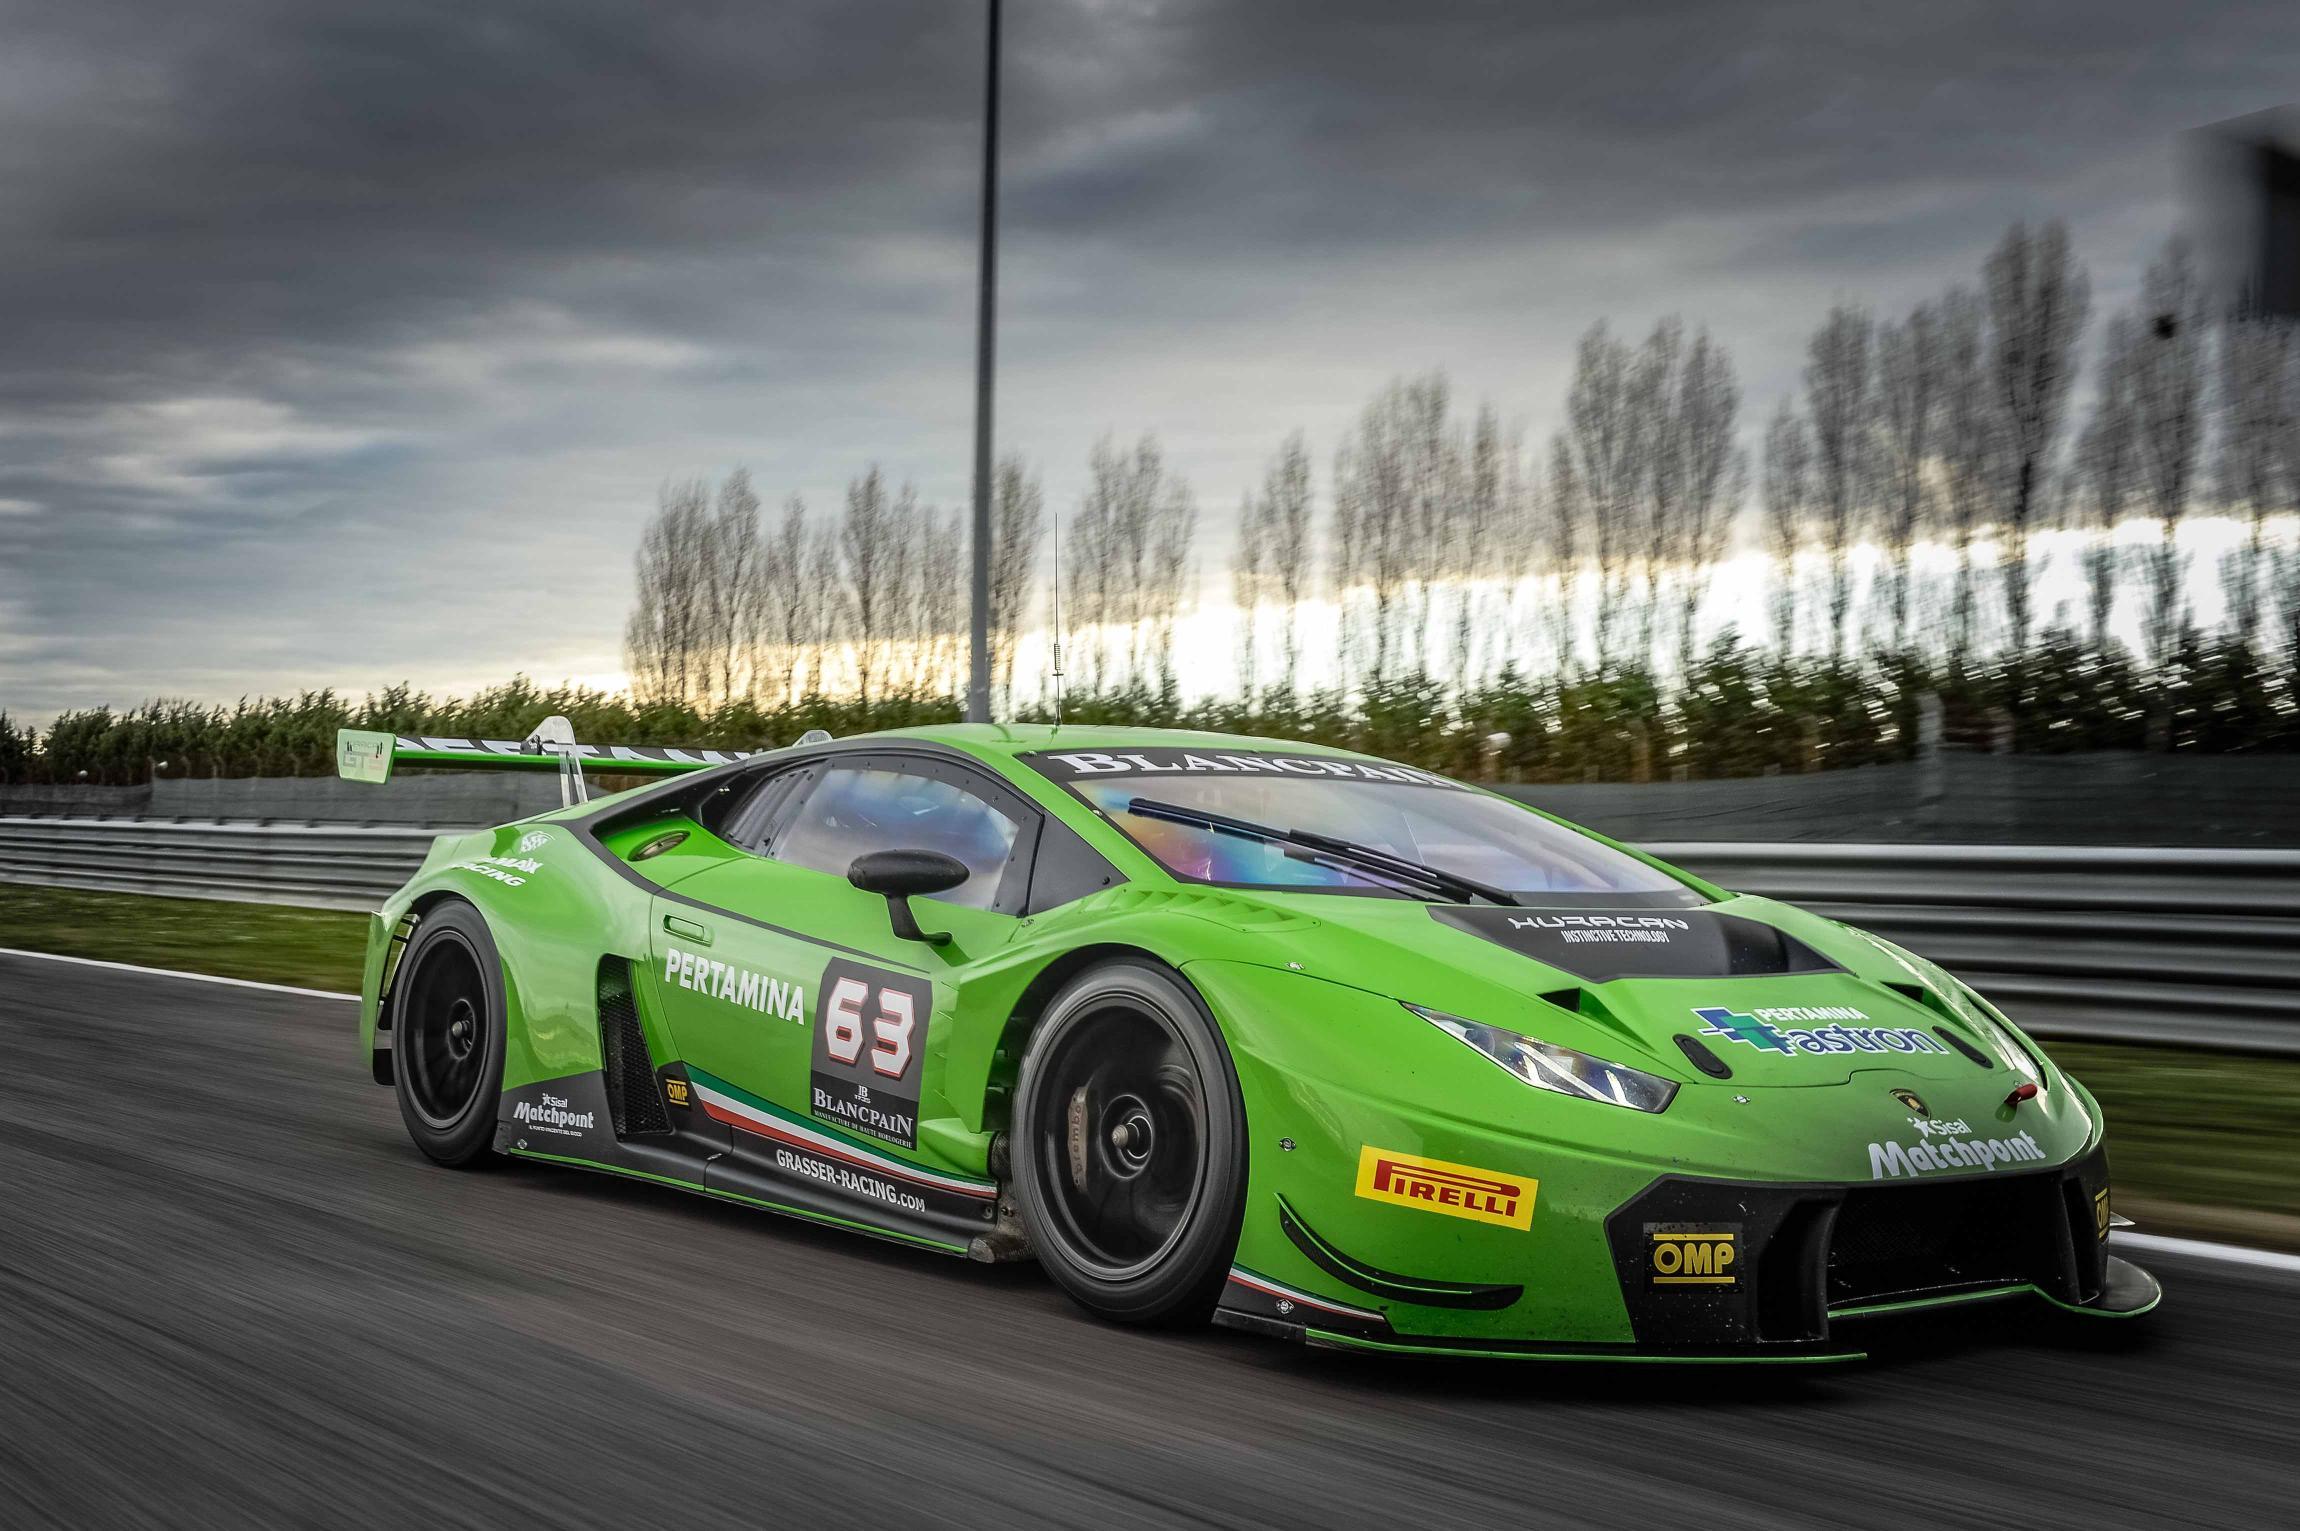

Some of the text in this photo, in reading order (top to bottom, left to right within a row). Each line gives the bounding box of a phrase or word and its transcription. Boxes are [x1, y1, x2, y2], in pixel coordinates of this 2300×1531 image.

[1047, 753, 1472, 791] BLANCPAIN
[1561, 929, 1670, 943] INSTINCTIVE TECHNOLOGY
[664, 947, 805, 1026] PERTAMINA
[825, 976, 915, 1080] 63
[1754, 1006, 1870, 1021] PERTAMINA
[551, 1097, 568, 1108] Sisal
[667, 1083, 688, 1102] OMP
[513, 1102, 594, 1129] Matchpoint
[813, 1087, 913, 1138] BLANCPAIN
[1930, 1118, 1972, 1136] Sisal
[1868, 1129, 2046, 1180] Matchpoint
[776, 1149, 925, 1212] GRASSER-RACING.COM
[1373, 1159, 1521, 1217] PIRELLI
[1653, 1242, 1735, 1275] OMP
